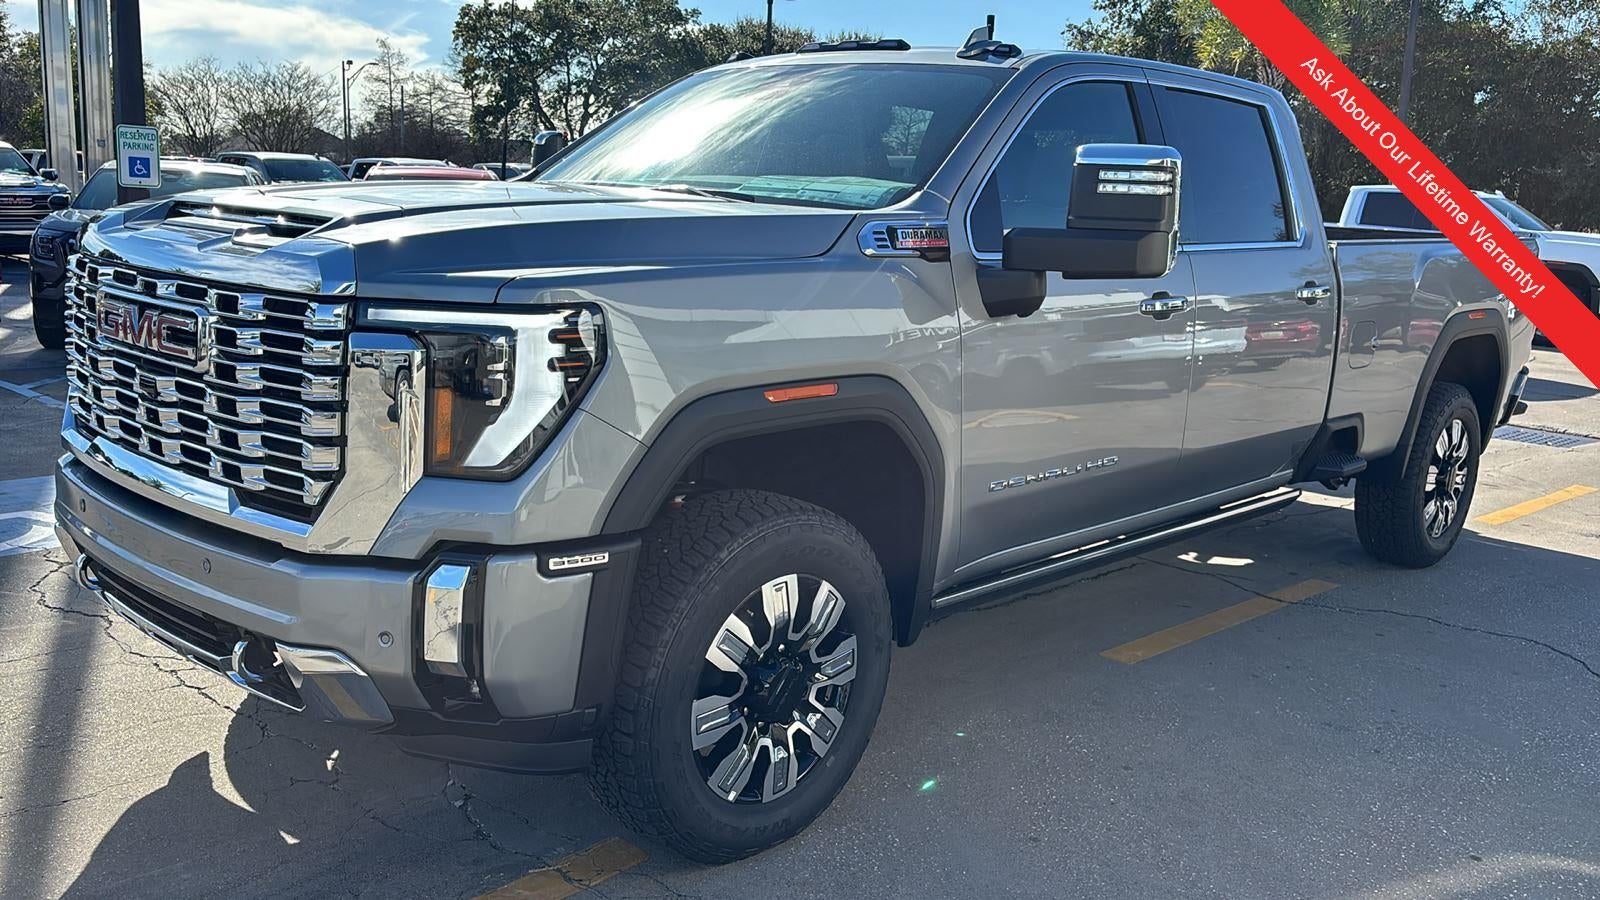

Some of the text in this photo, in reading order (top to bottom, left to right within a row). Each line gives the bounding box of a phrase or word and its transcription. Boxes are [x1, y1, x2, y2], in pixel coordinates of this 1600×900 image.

[120, 130, 156, 141] RESERVED
[123, 142, 155, 151] PARKING
[901, 230, 945, 240] DURAMAX
[97, 301, 196, 360] GMC
[989, 455, 1119, 492] DENALI HD
[549, 551, 609, 570] 3500
